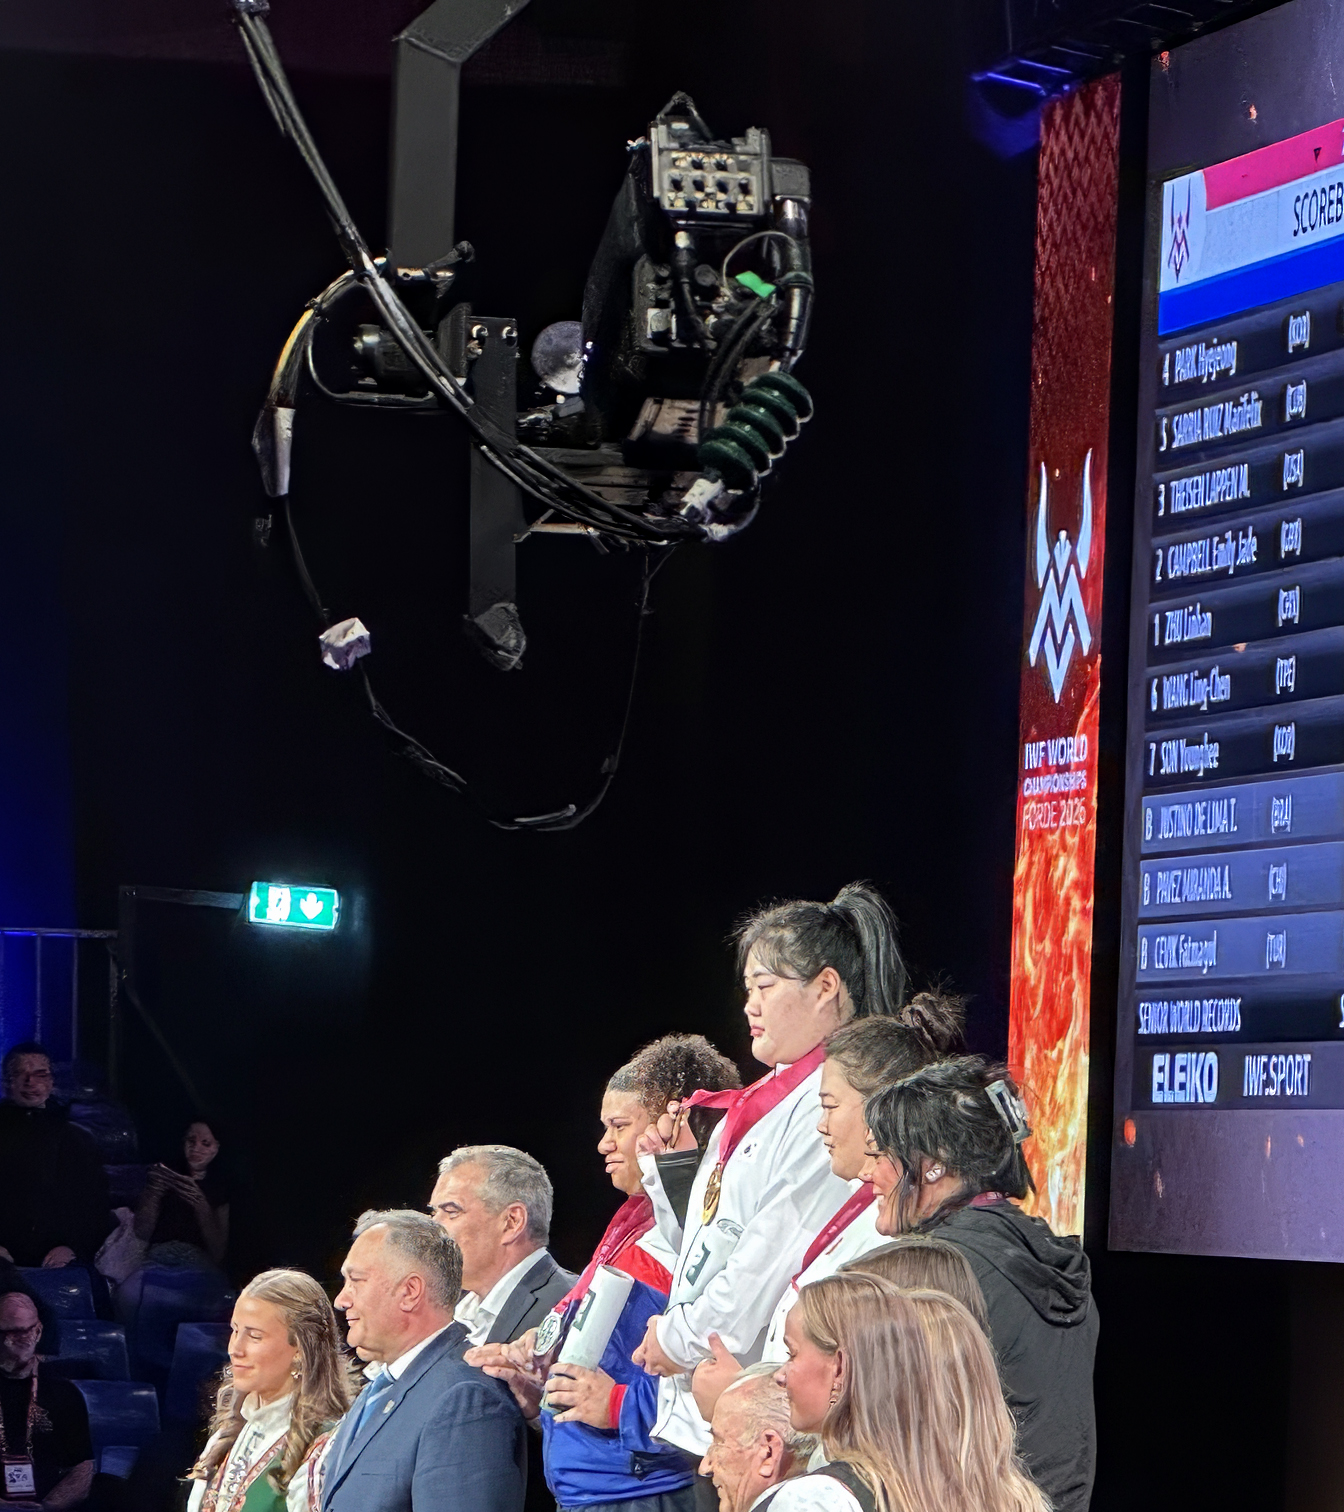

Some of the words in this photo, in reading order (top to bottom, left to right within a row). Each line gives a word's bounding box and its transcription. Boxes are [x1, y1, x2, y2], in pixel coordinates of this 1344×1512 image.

[1161, 352, 1169, 387] 4
[1157, 483, 1165, 516] 3
[1155, 548, 1163, 581] 2
[1154, 613, 1160, 645] 1
[1150, 678, 1157, 711] 6
[1024, 741, 1046, 769] IWF
[1047, 734, 1087, 766] WORLD
[1149, 742, 1156, 776] 7
[1158, 802, 1193, 840] JUSTINO
[1194, 800, 1206, 834] DE
[1151, 1051, 1218, 1103] ELEIKO
[1243, 1053, 1311, 1097] IWF.SPORT
